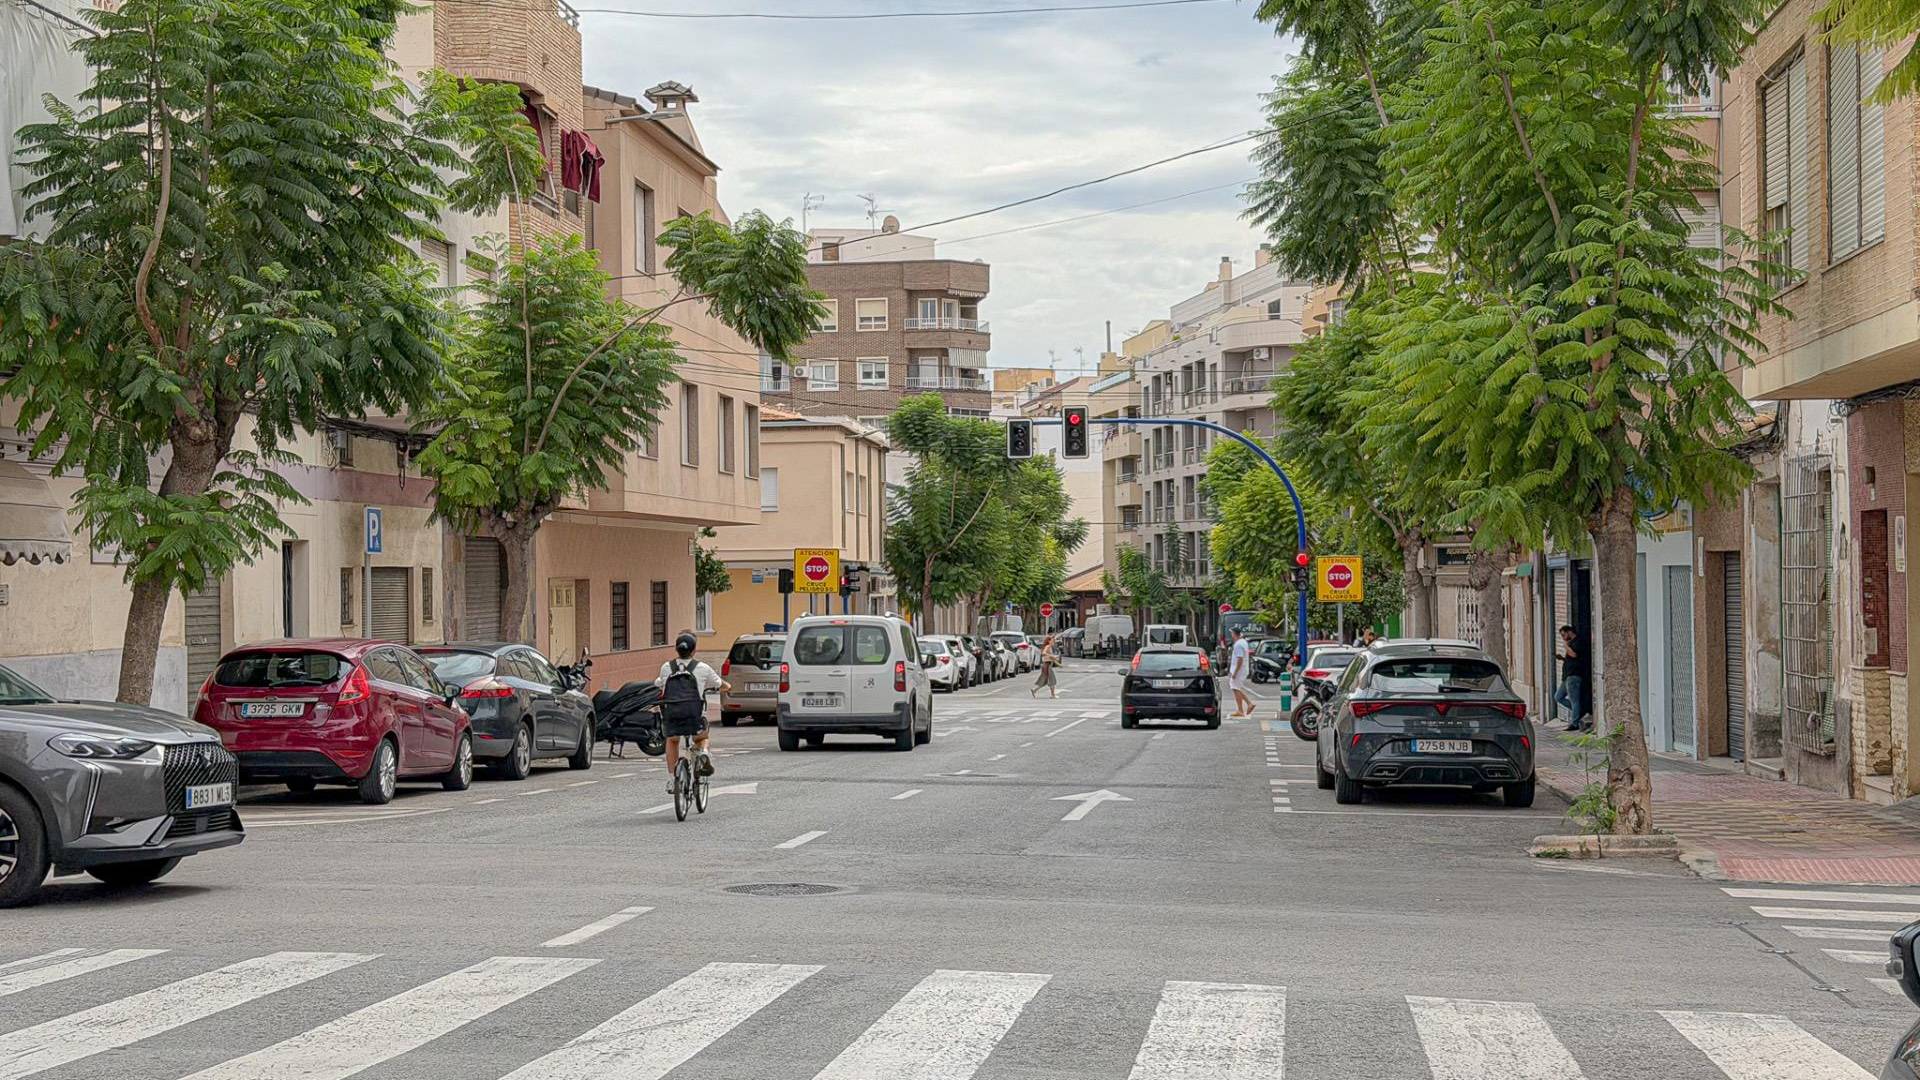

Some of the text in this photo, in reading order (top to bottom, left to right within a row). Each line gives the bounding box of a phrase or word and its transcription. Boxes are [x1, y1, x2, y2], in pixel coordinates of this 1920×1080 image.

[369, 512, 379, 548] P
[806, 565, 828, 573] STOP
[1329, 573, 1351, 581] STOP
[251, 704, 301, 714] 3795 GKW
[1419, 741, 1468, 751] 2758 NJB
[193, 788, 214, 805] 8831
